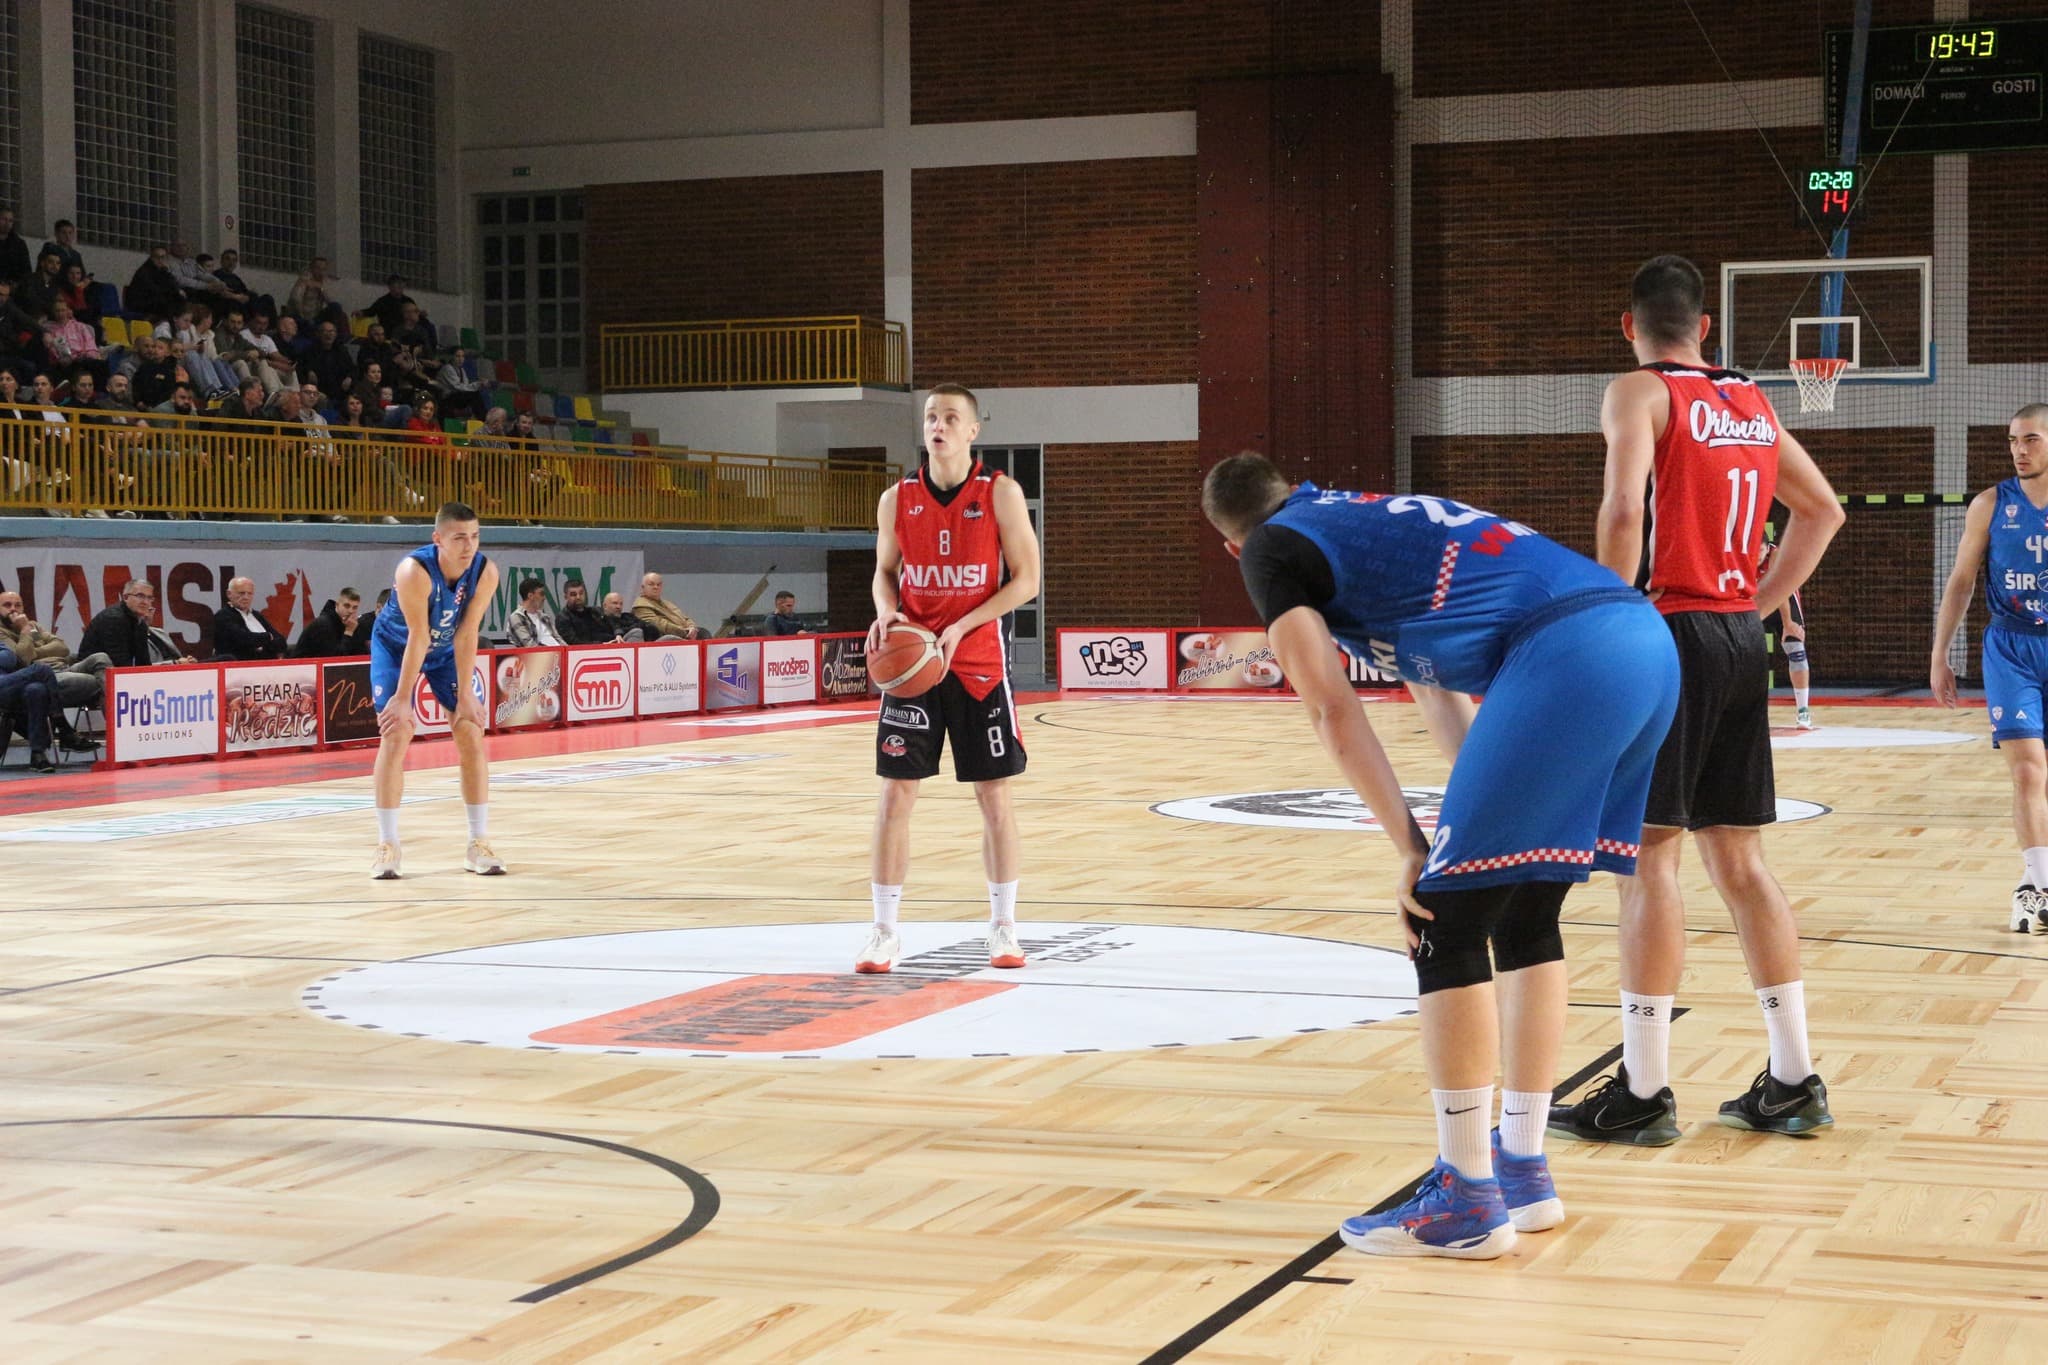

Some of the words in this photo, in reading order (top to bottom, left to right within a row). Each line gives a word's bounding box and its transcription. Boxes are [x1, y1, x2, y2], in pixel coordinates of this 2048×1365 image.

[1929, 31, 1994, 59] 19:43
[1992, 79, 2036, 94] GOSTI
[1809, 171, 1852, 190] 02:28
[1823, 191, 1848, 213] 14
[1724, 467, 1759, 554] 11
[939, 529, 951, 556] 8
[905, 563, 988, 588] NANSI
[767, 657, 810, 677] FRIGOŠPED
[243, 683, 302, 703] PEKARA
[653, 683, 663, 691] PVC
[138, 730, 193, 742] SOLUTIONS
[987, 726, 1005, 757] 8
[1628, 1003, 1655, 1017] 23
